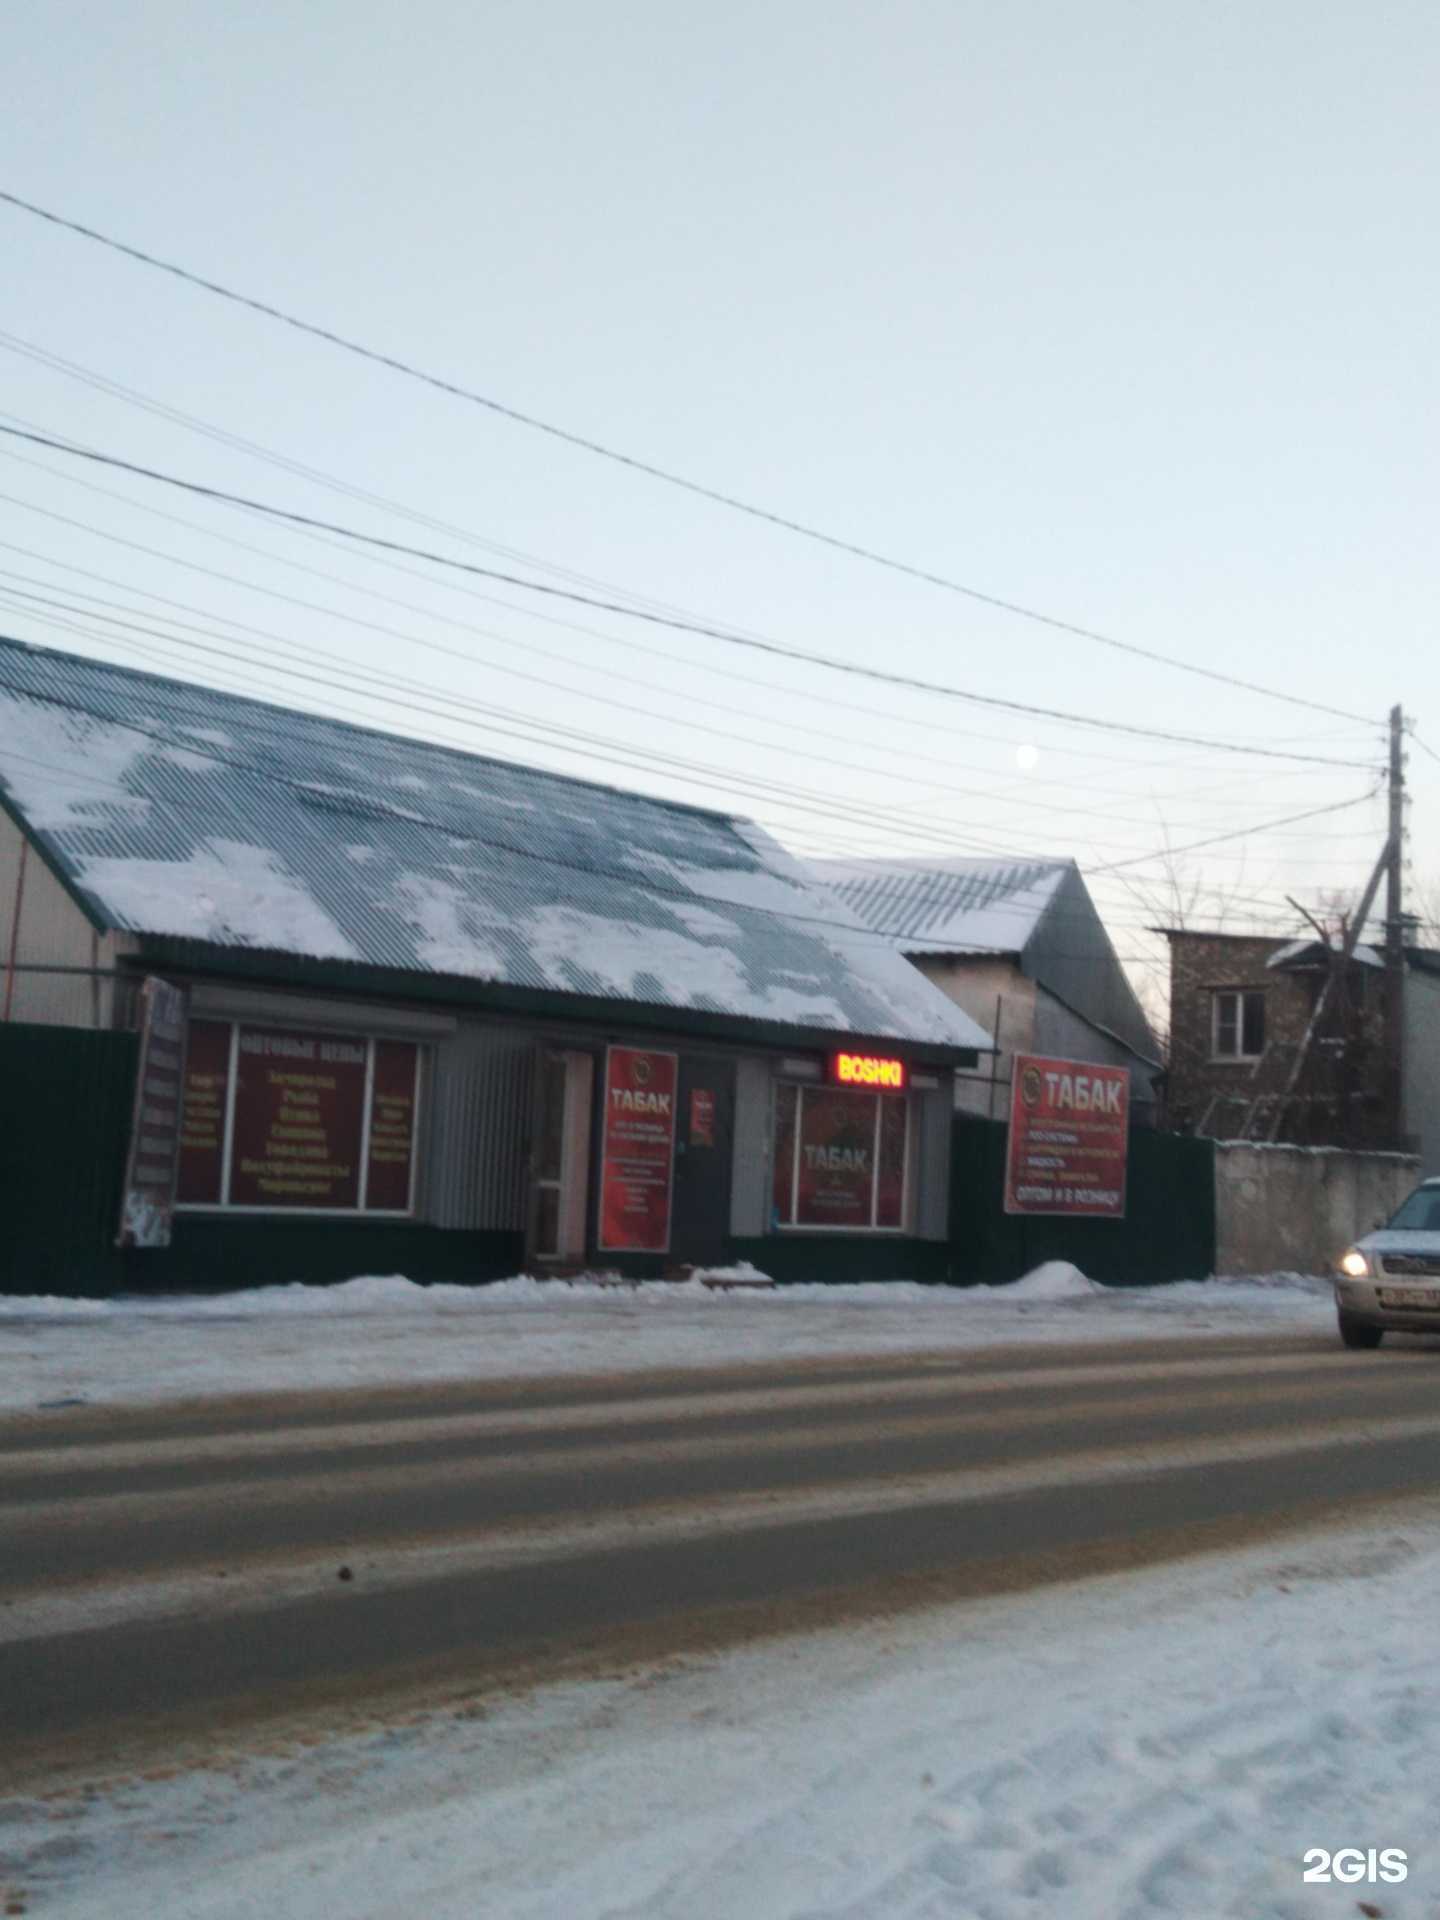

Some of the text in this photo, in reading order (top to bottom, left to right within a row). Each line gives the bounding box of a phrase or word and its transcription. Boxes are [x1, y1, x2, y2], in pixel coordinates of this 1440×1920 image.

[838, 1054, 903, 1087] BOSHKI
[611, 1088, 672, 1115] ТАБАК
[1045, 1072, 1121, 1113] ТАБАК
[804, 1144, 868, 1171] ТАБАК
